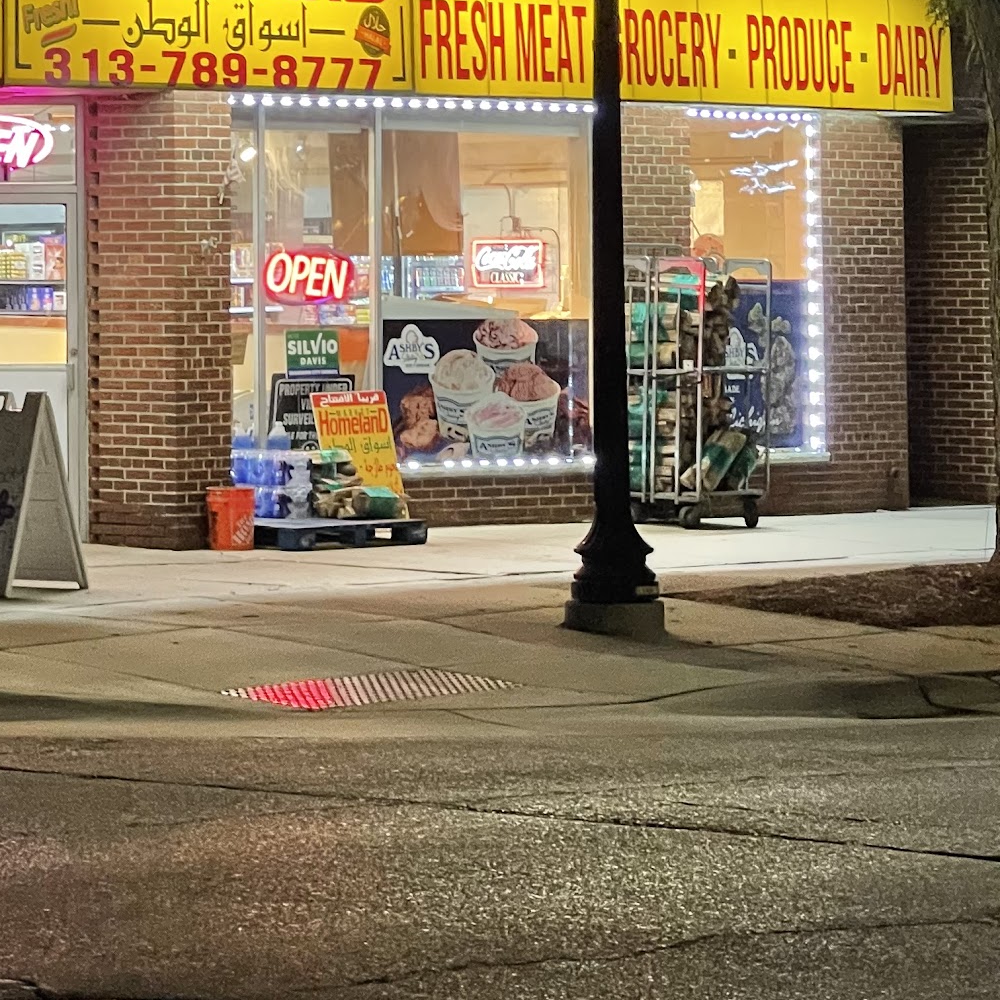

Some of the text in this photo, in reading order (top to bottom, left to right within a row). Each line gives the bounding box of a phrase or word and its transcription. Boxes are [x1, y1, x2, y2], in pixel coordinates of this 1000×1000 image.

[420, 0, 944, 98] FRESH MEAT ROCERY PRODUCE DAIRY
[45, 47, 382, 92] 313-789-8777
[266, 252, 349, 299] OPEN
[287, 333, 339, 356] SILVIO
[300, 356, 327, 366] DAVIS
[279, 382, 320, 396] PROPERTY
[318, 408, 388, 437] HomelanD
